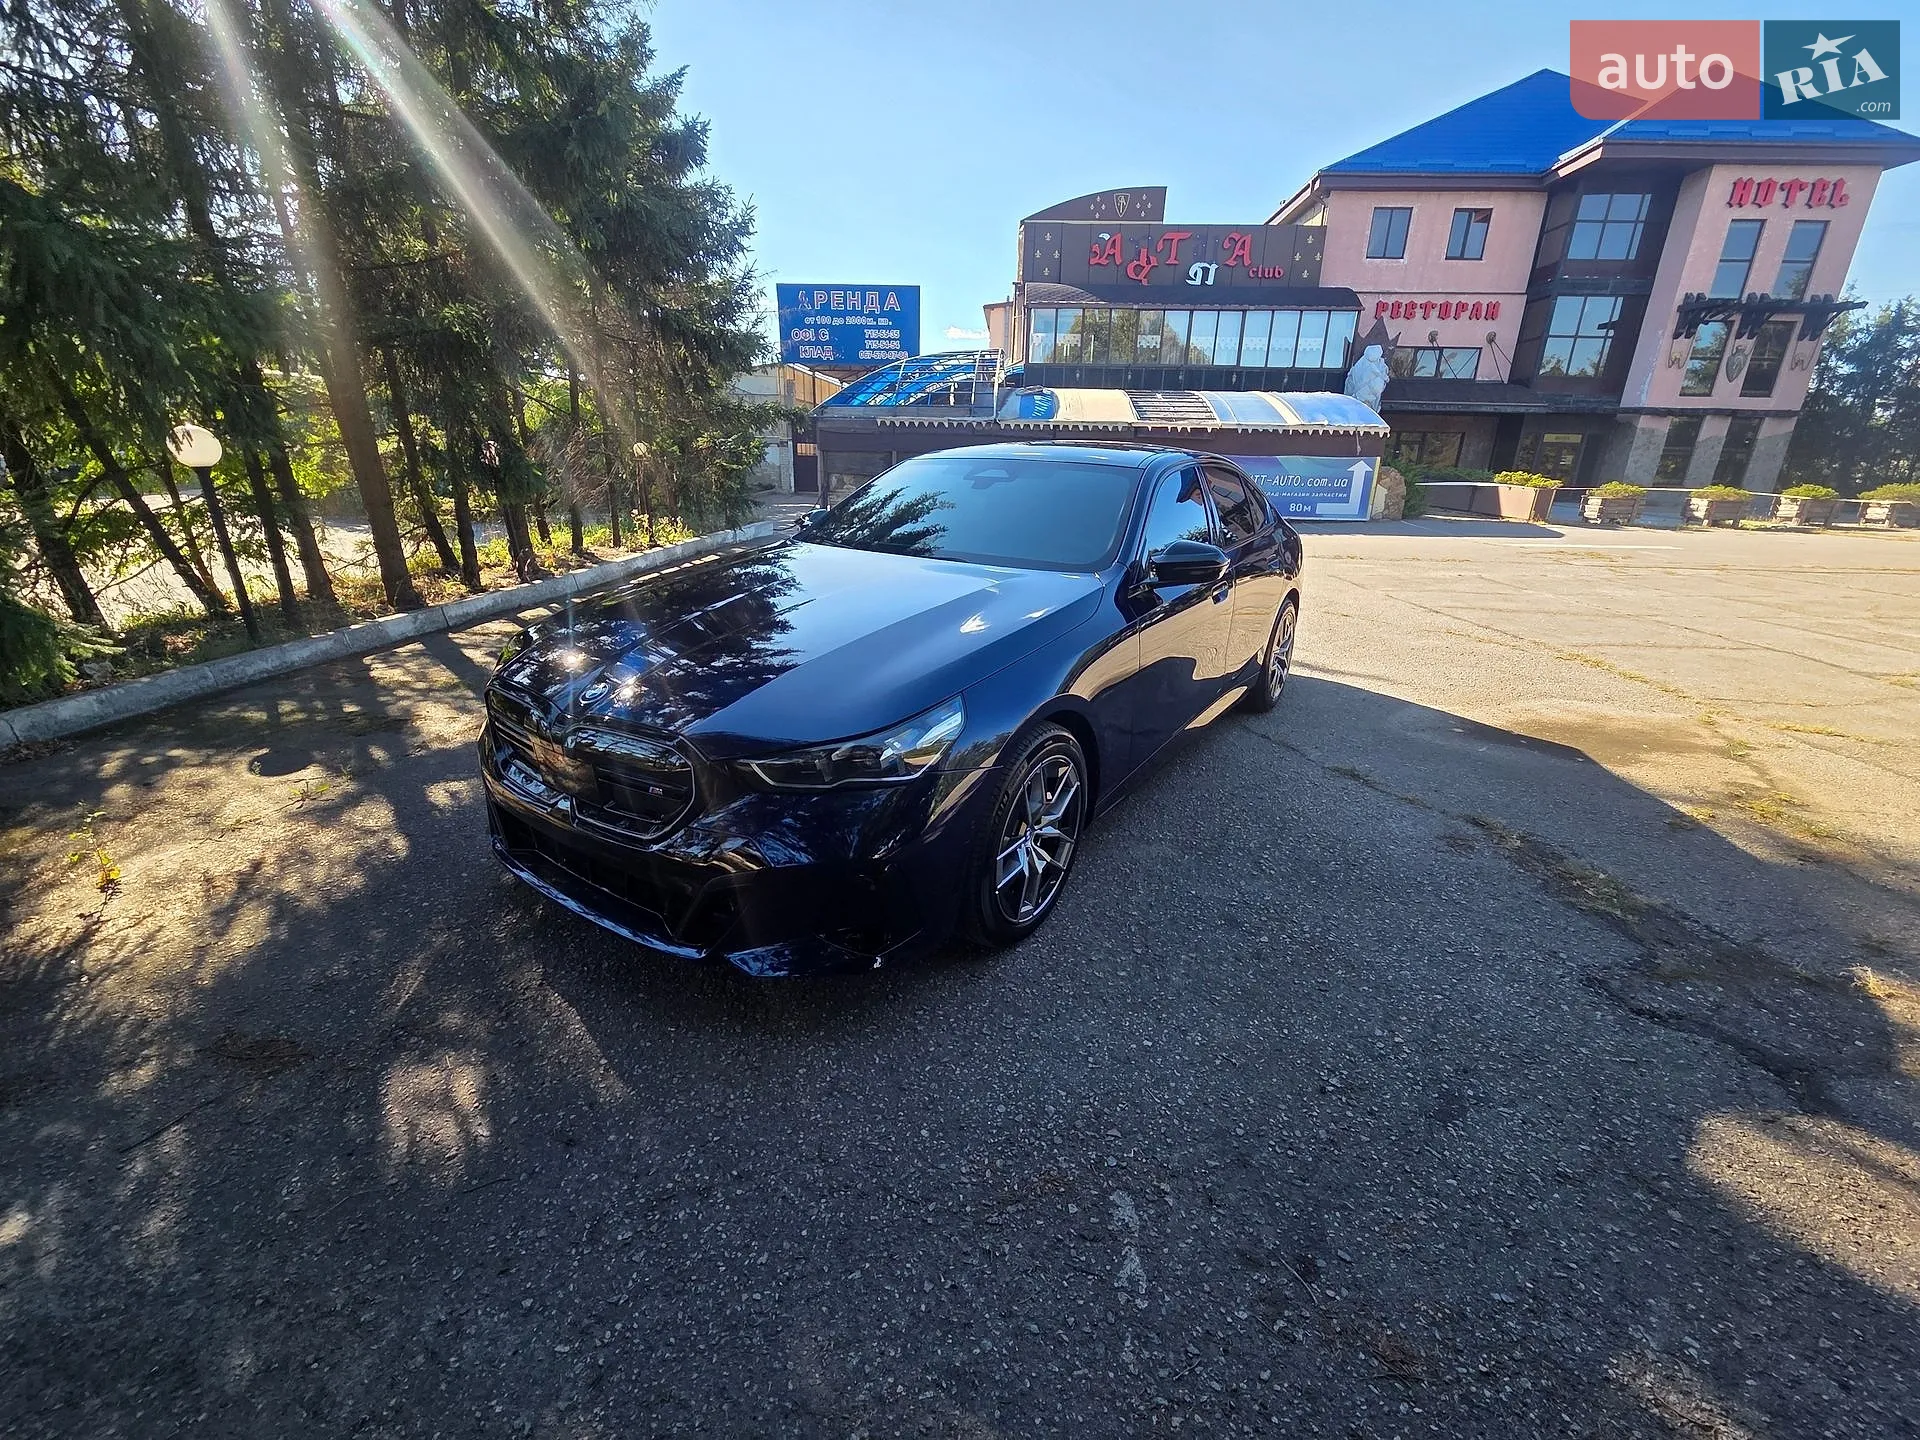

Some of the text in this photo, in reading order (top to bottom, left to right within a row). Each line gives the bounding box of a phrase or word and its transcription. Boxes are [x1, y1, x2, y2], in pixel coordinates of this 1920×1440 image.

[1726, 177, 1850, 209] HOTEL
[1249, 264, 1285, 280] club
[1374, 300, 1501, 321] РЕСТОРАН
